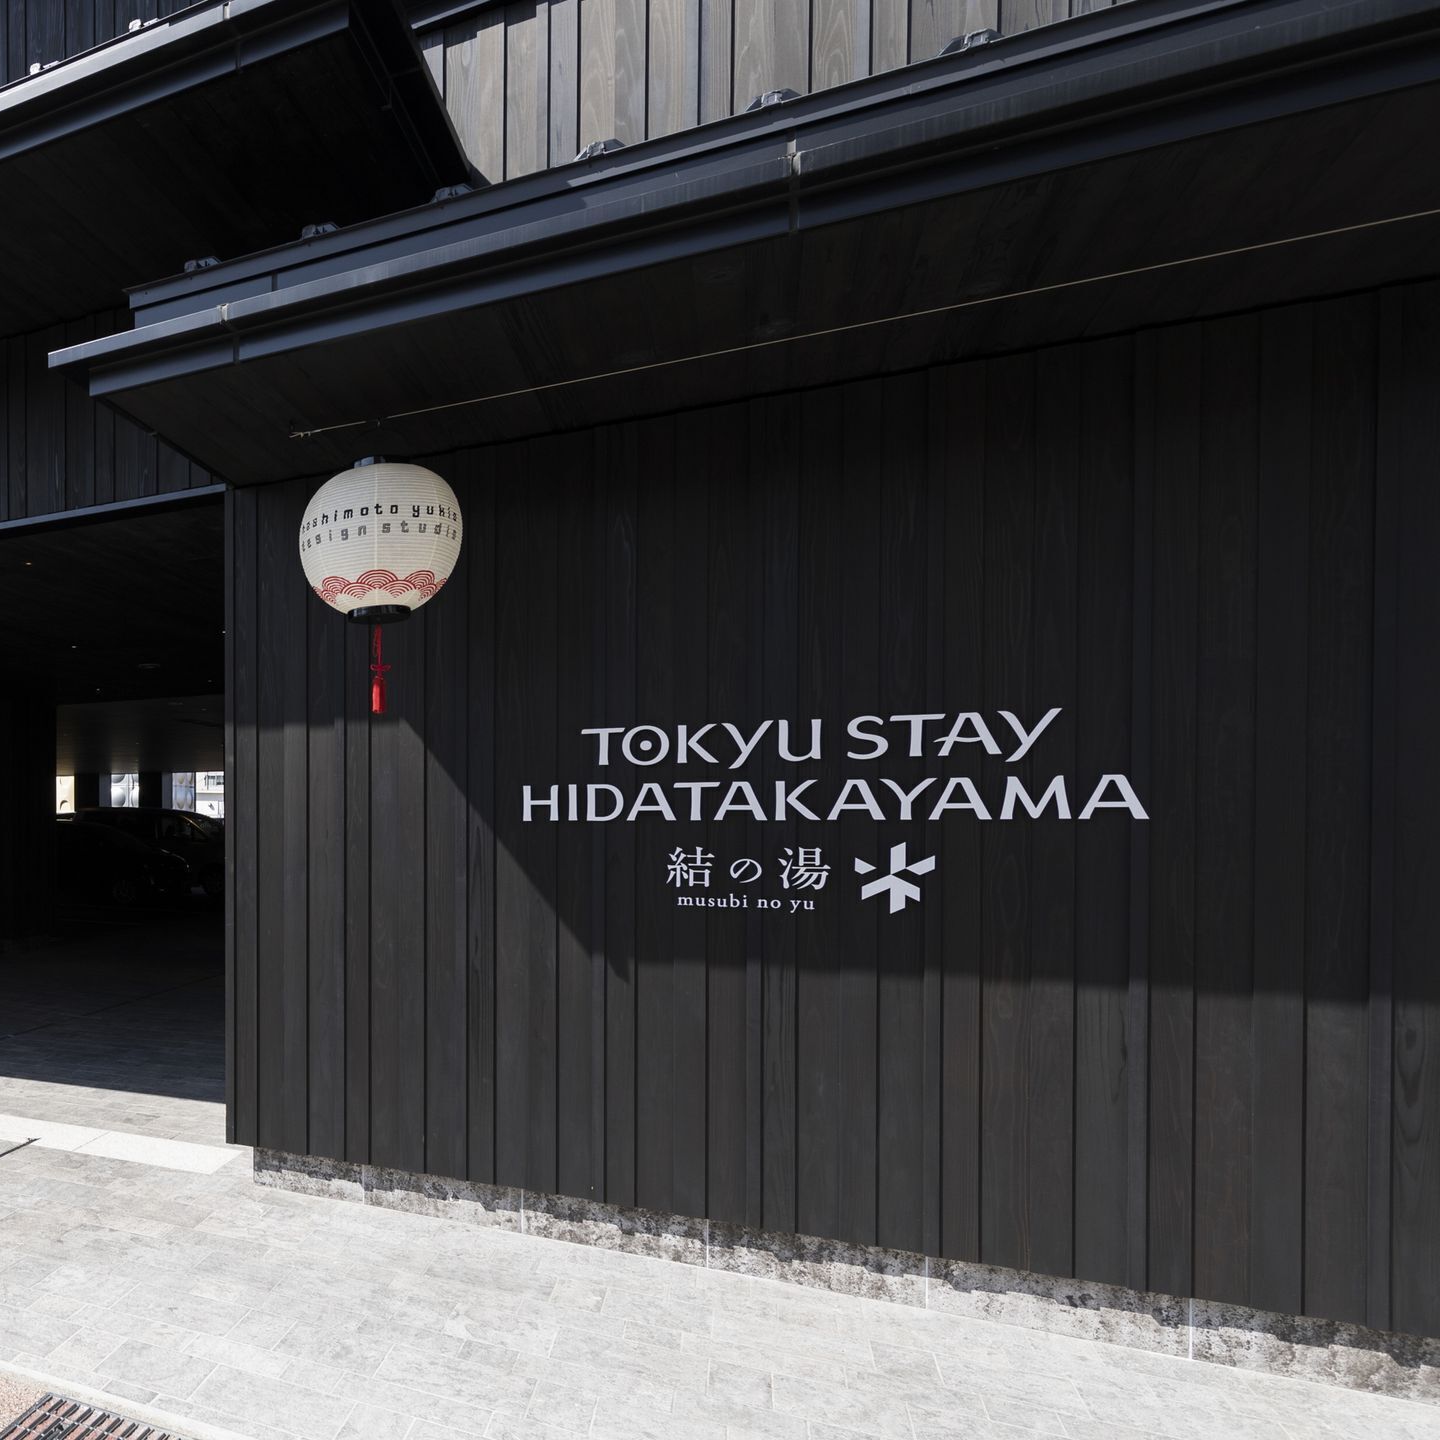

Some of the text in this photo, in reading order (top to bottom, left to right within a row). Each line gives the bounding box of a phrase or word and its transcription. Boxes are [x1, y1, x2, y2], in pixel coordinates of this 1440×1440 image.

[381, 519, 458, 541] studio
[580, 707, 1063, 769] TOKYU STAY
[522, 773, 1150, 822] HIDATAKAYAMA
[666, 846, 831, 890] 結の湯
[677, 893, 815, 914] musubi no yu
